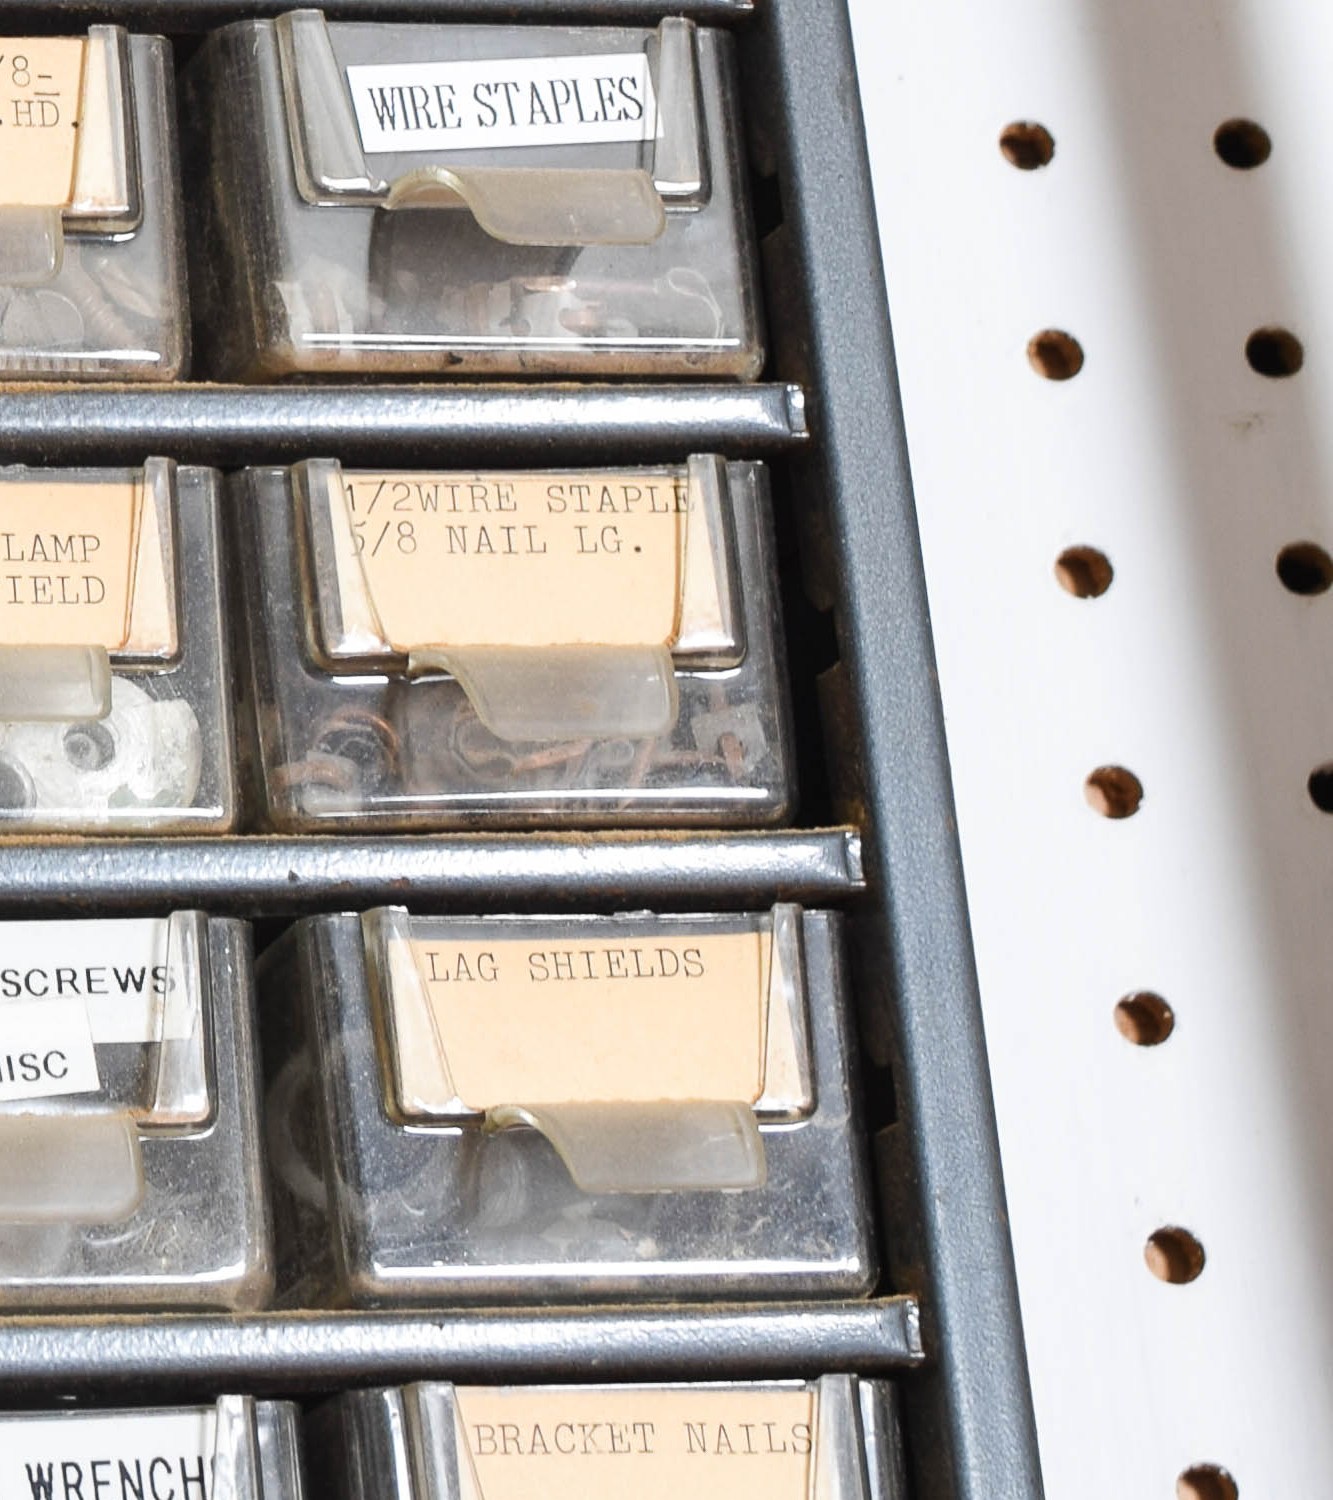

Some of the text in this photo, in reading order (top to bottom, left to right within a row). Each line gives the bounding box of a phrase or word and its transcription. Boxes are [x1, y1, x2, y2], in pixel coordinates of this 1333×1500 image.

[367, 76, 645, 132] WIRE STAPLES
[446, 525, 643, 555] NAIL LG.
[0, 965, 177, 997] SCREWS
[426, 948, 705, 982] LAG SHIELDS
[472, 1421, 812, 1456] BRACKET NAILS
